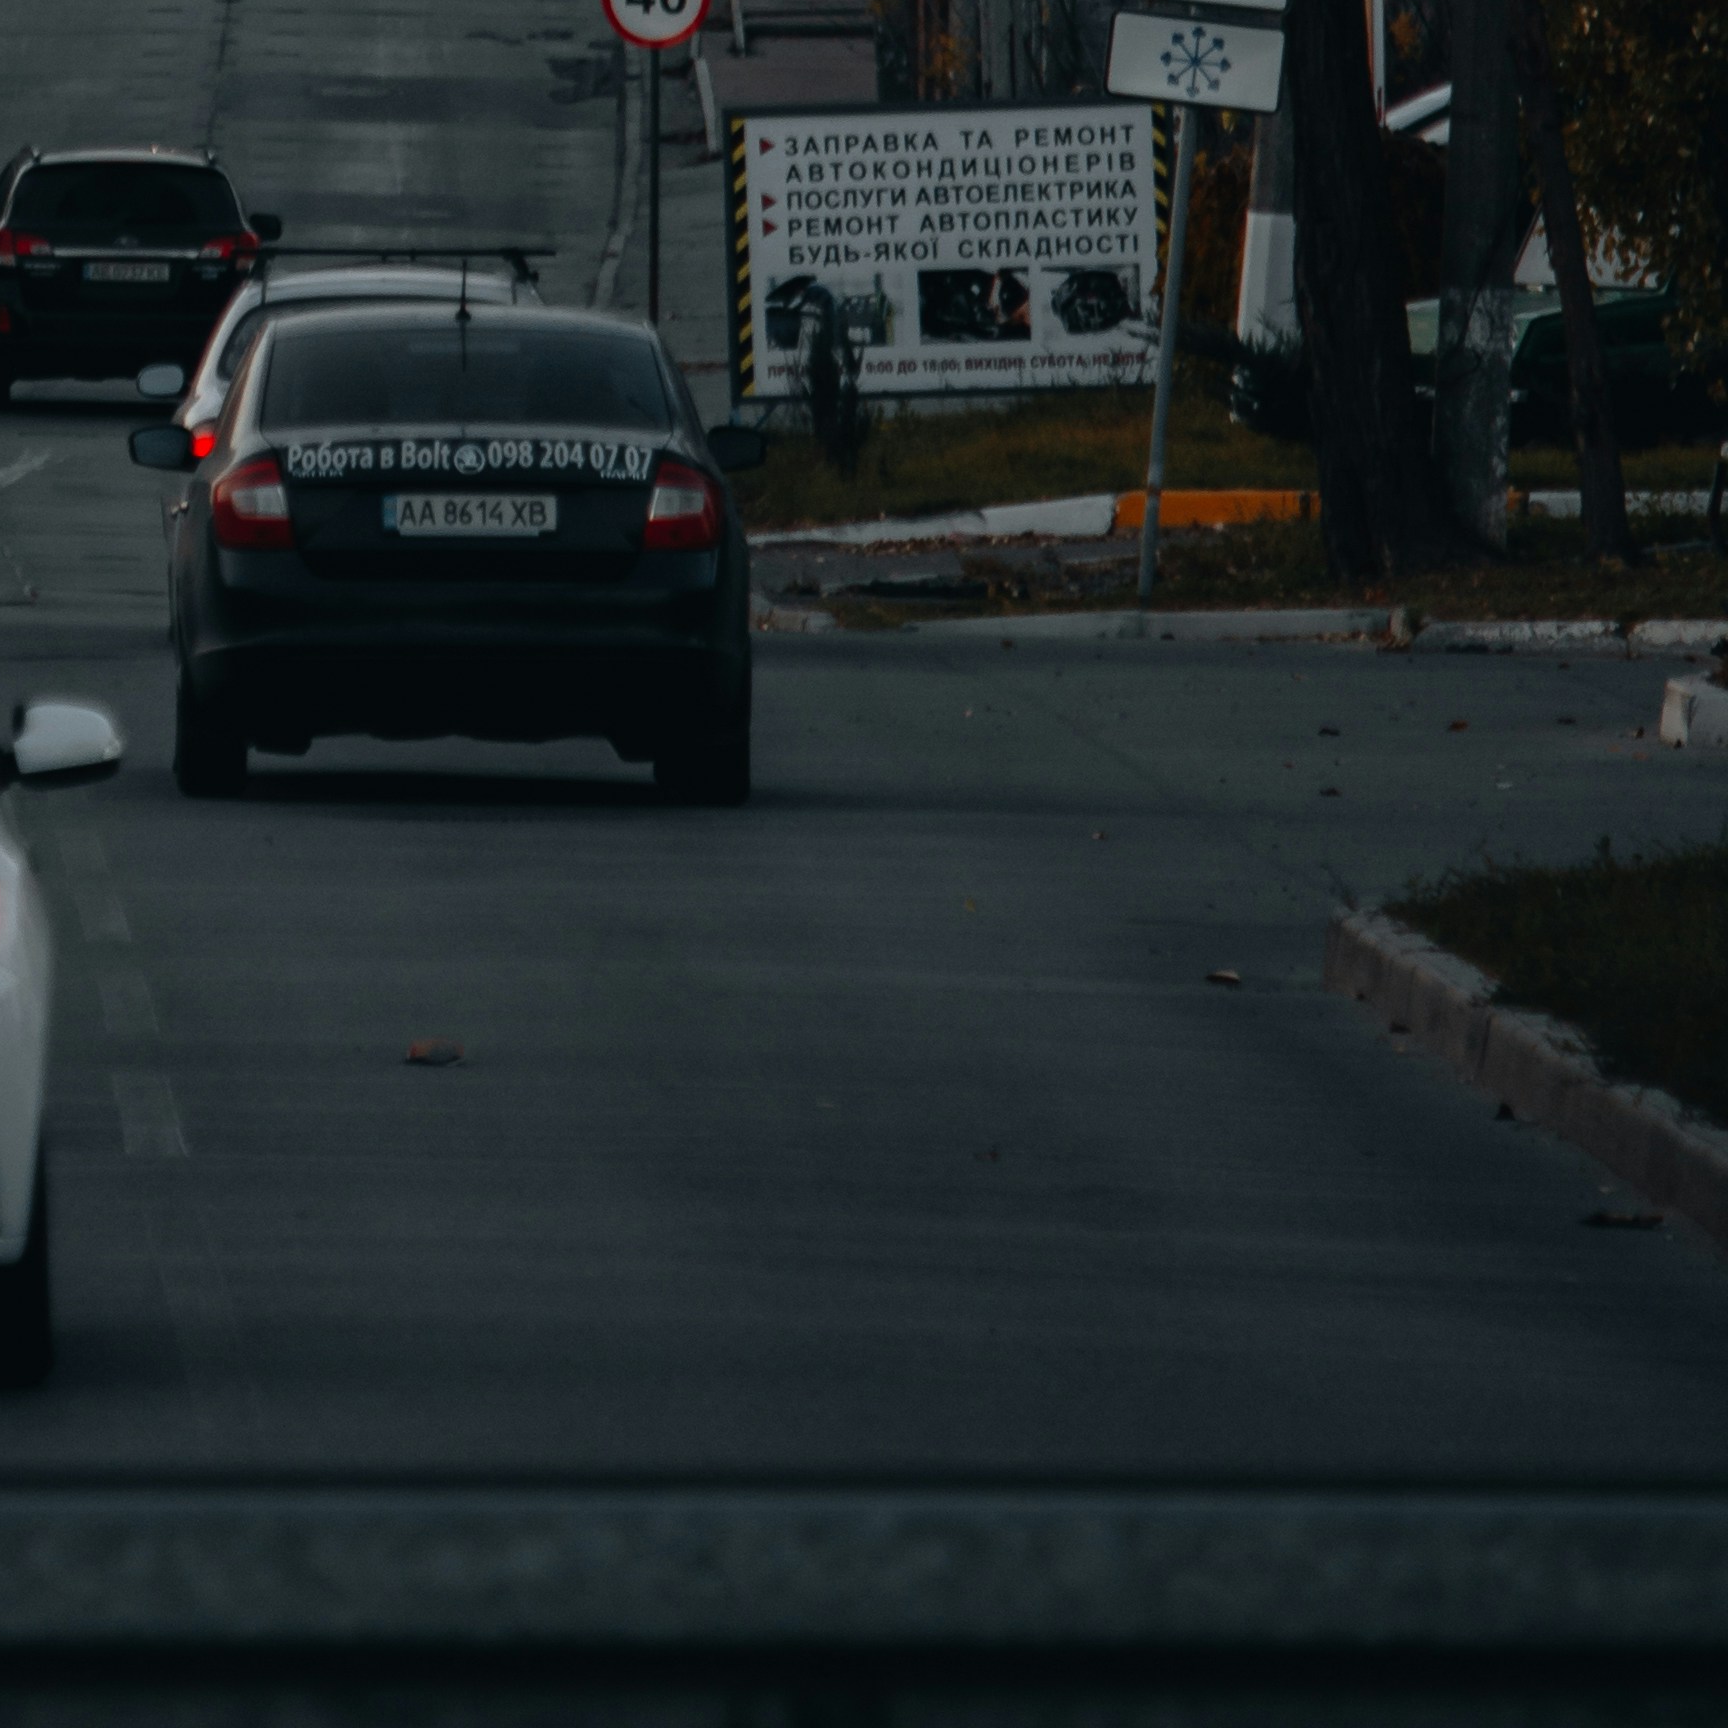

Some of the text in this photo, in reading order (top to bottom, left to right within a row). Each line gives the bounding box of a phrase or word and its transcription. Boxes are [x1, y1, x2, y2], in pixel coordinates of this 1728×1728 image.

[785, 125, 1134, 156] ЗАПРАВКА ТА РЕМОНТ
[786, 152, 1136, 184] АВТОКОНДИЦІОНЕРІВ
[786, 179, 1137, 210] ПОСЛУГИ АВТОЕЛЕКТРИКА
[788, 207, 1138, 238] РЕМОНТ АВТОПЛАСТИКУ
[789, 234, 1139, 267] БУДЬ-ЯКОЇ СКЛАДНОСТІ
[897, 359, 918, 375] ДО
[288, 442, 373, 472] Робота
[380, 446, 395, 470] в
[401, 440, 451, 471] Bolt
[487, 441, 534, 469] 098
[539, 442, 584, 470] 204
[590, 443, 619, 474] 07
[624, 445, 653, 476] 07
[400, 499, 547, 527] AA 8614 XB
